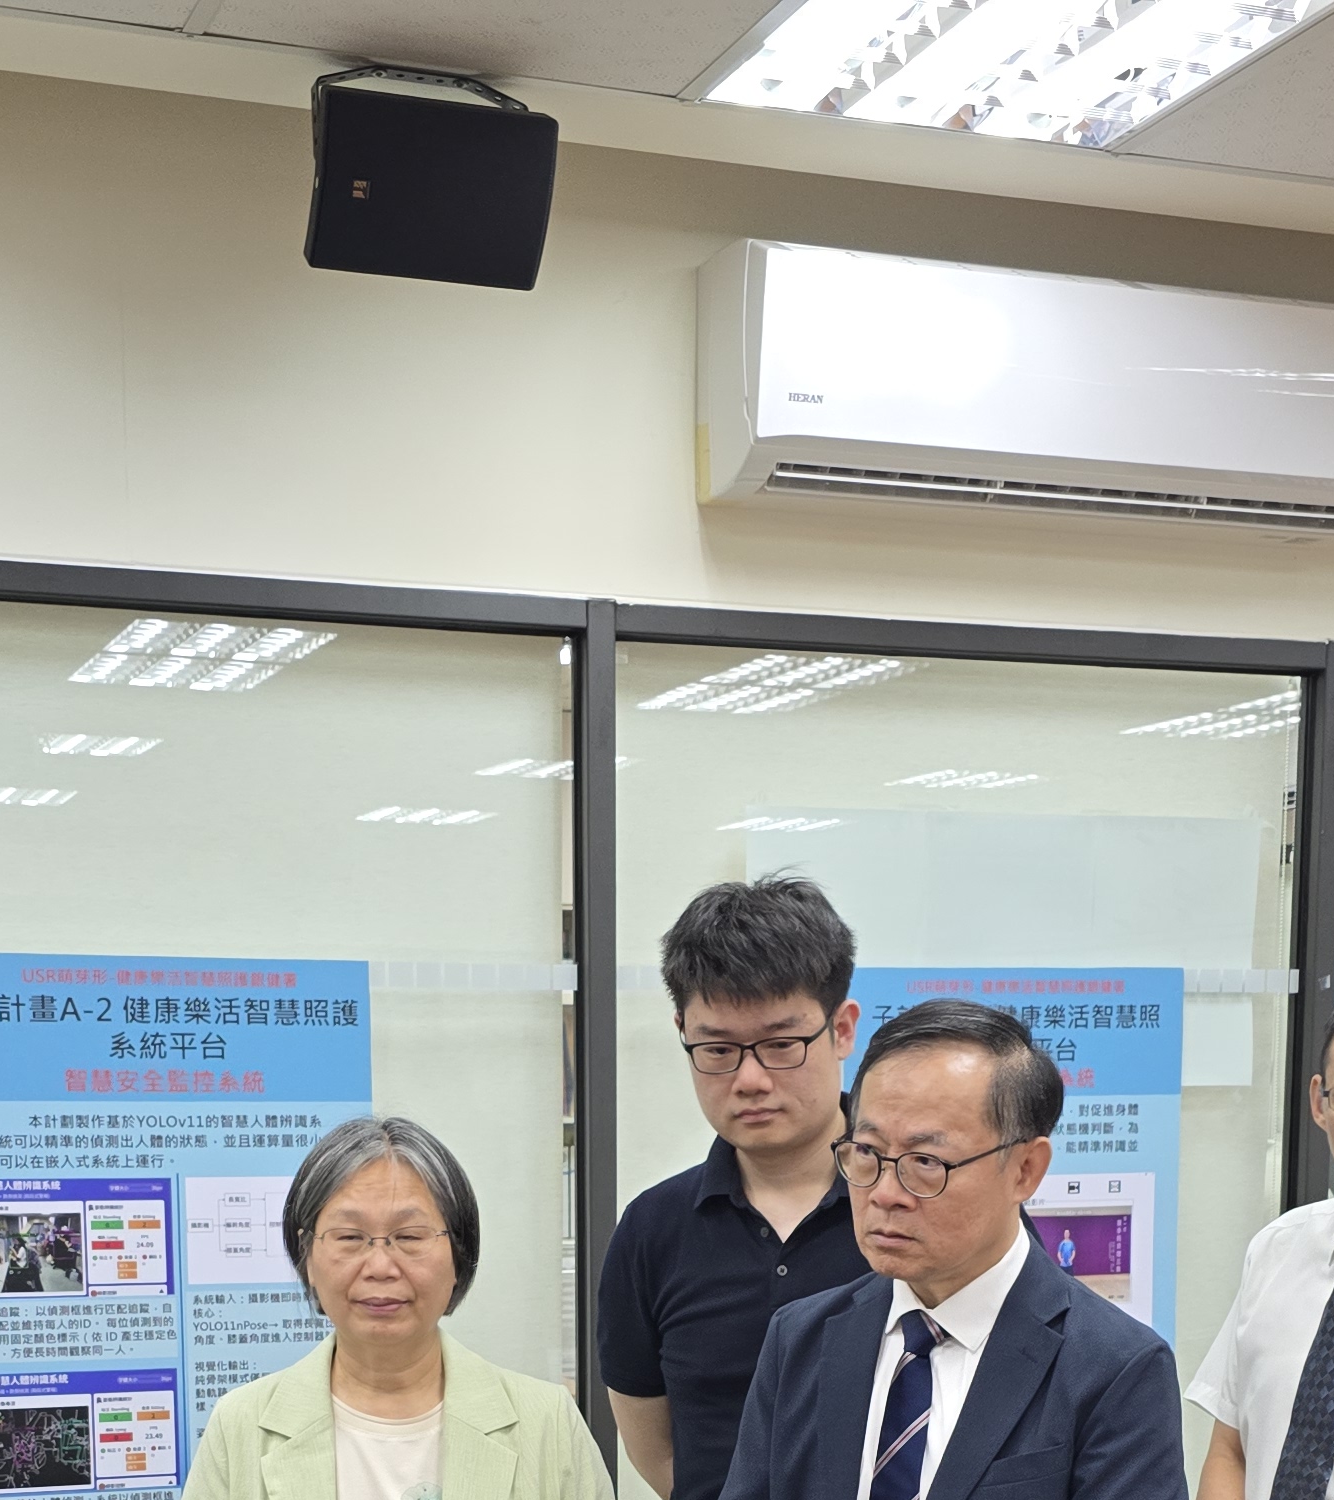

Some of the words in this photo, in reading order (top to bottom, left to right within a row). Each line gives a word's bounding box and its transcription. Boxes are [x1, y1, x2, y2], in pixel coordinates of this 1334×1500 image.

[788, 392, 824, 404] HERAN
[21, 968, 298, 988] USR萌芽形-健康樂活智慧照護銀健署
[122, 997, 360, 1027] 健康樂活智慧照護
[109, 1031, 228, 1060] 系統平台
[65, 1069, 265, 1094] 智慧安全監控系統
